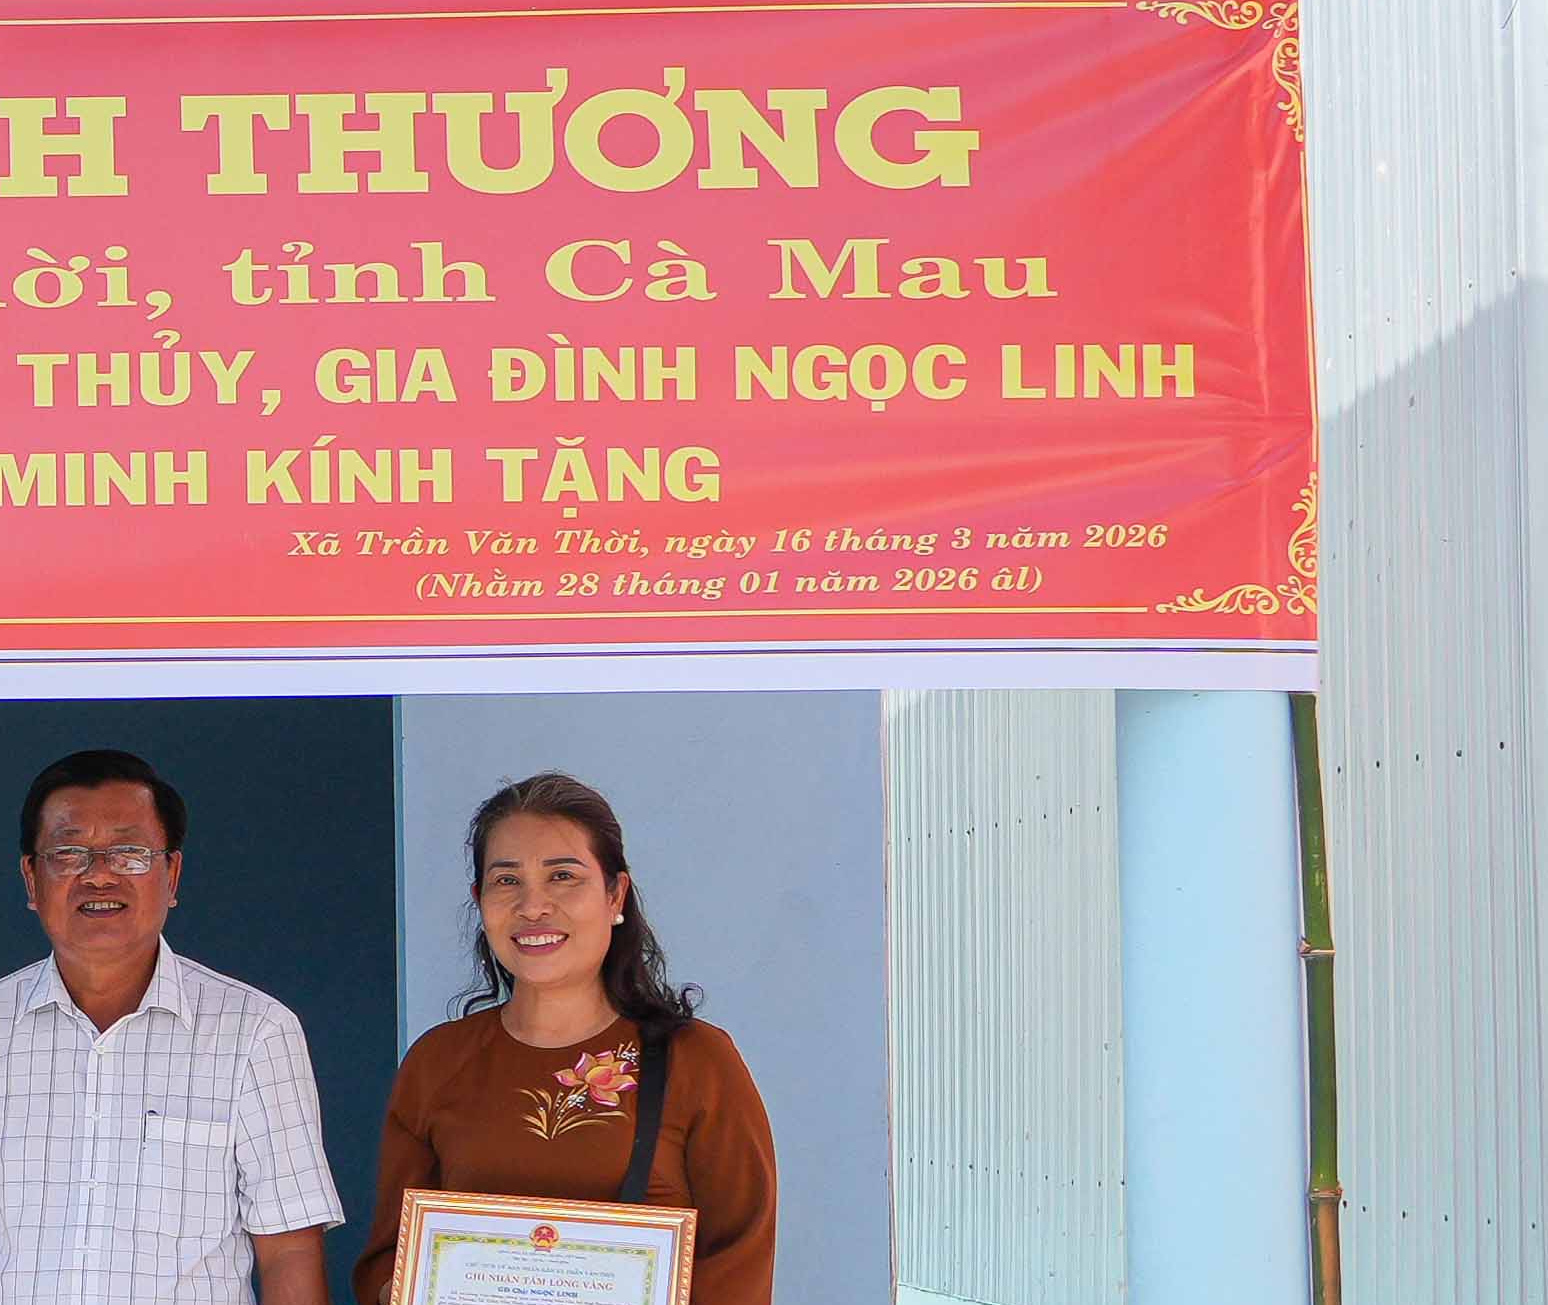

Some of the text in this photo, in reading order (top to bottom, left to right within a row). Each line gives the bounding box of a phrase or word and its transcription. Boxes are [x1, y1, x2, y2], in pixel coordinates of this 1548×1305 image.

[180, 64, 982, 196] THƯƠNG
[222, 240, 494, 307] tỉnh
[542, 237, 720, 303] Cà
[769, 237, 1058, 301] Mau
[17, 327, 283, 416] THỦY,
[315, 346, 459, 405] GIA
[488, 331, 699, 403] ĐÌNH
[735, 342, 969, 412] NGỌC
[1001, 341, 1197, 401] LINH
[245, 435, 455, 505] KÍNH
[485, 435, 722, 521] TẶNG
[287, 524, 1168, 559] Xã Trần Văn Thời, ngày 16 tháng 3 năm 2026
[416, 565, 1043, 600] (Nhằm 28 tháng 01 năm 2026 âl)
